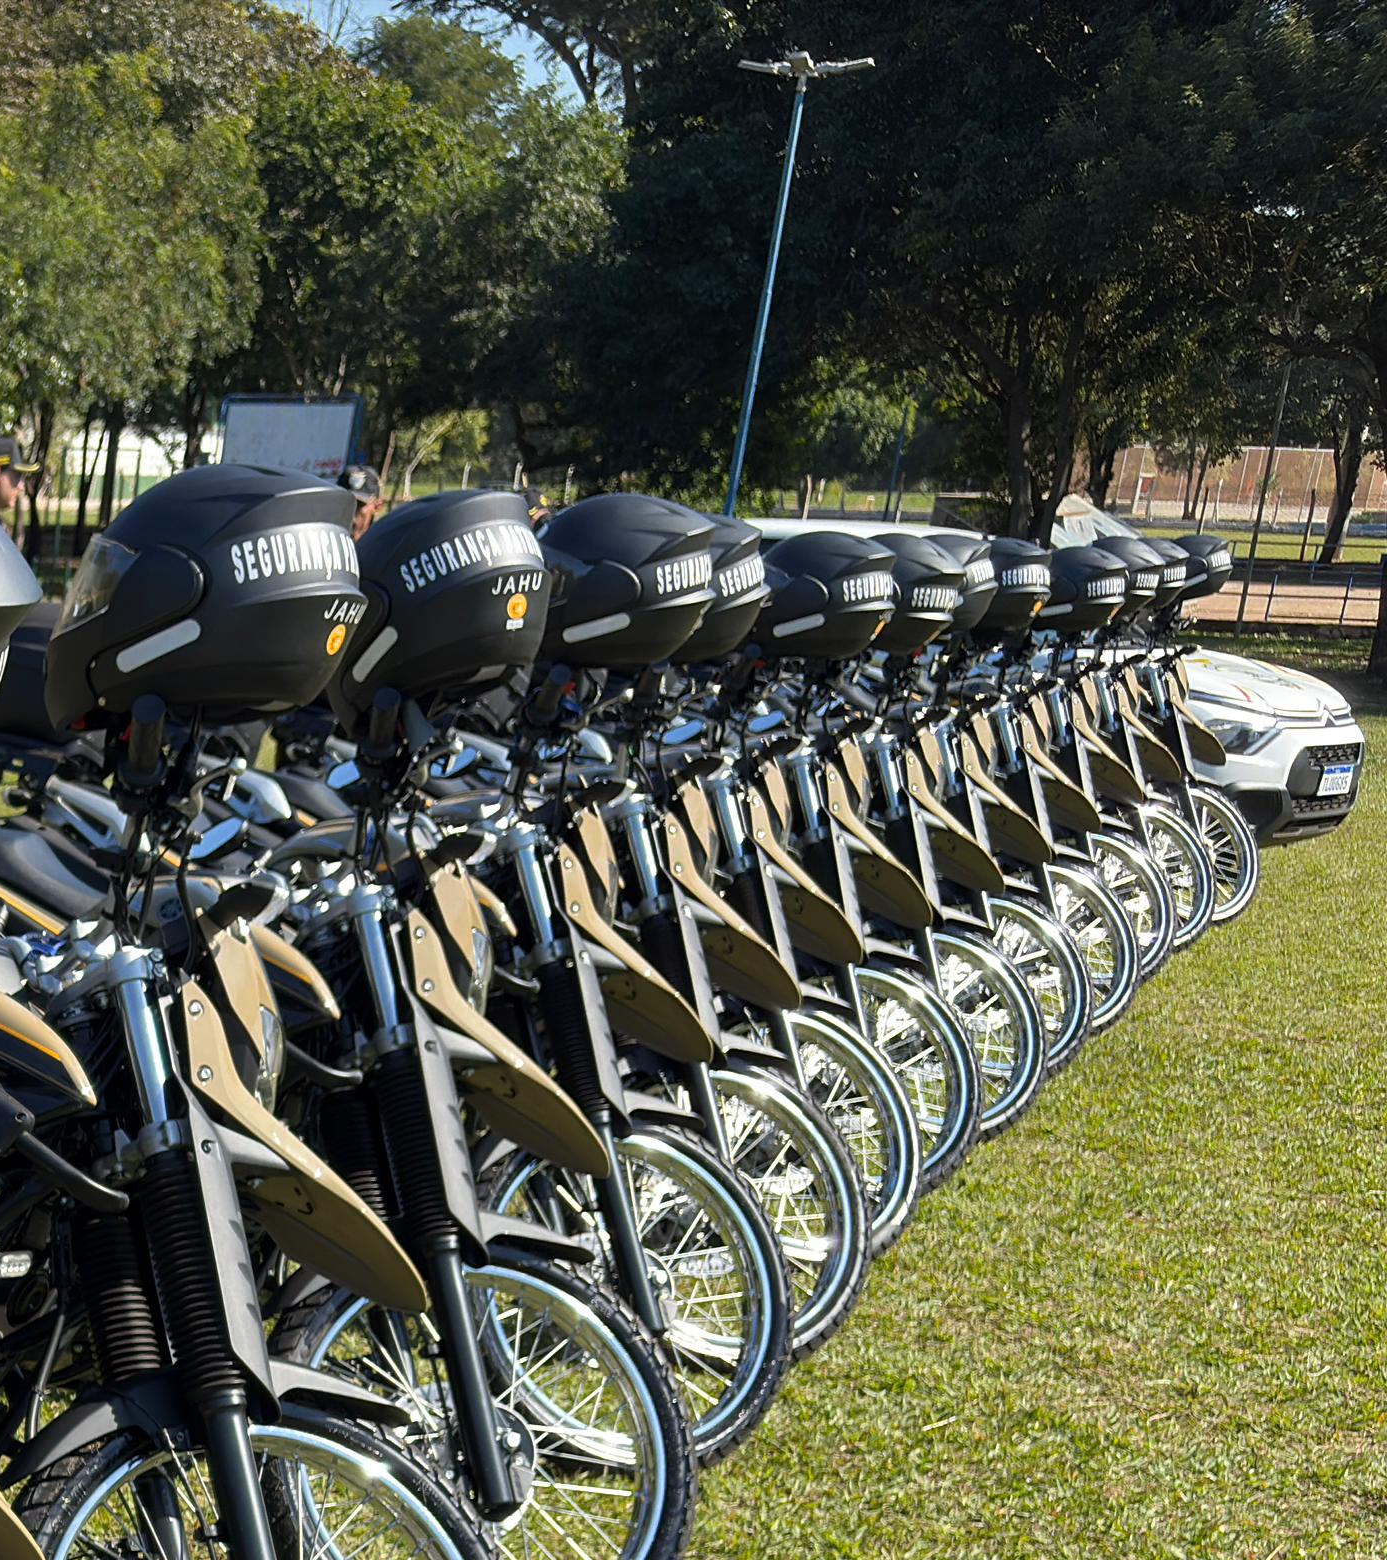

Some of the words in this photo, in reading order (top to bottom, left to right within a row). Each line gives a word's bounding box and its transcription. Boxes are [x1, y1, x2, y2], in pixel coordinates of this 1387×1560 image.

[230, 530, 342, 583] SEGURANÇA
[400, 528, 502, 592] SEGURANÇA
[491, 571, 543, 595] JAHU
[324, 598, 367, 625] JAHU
